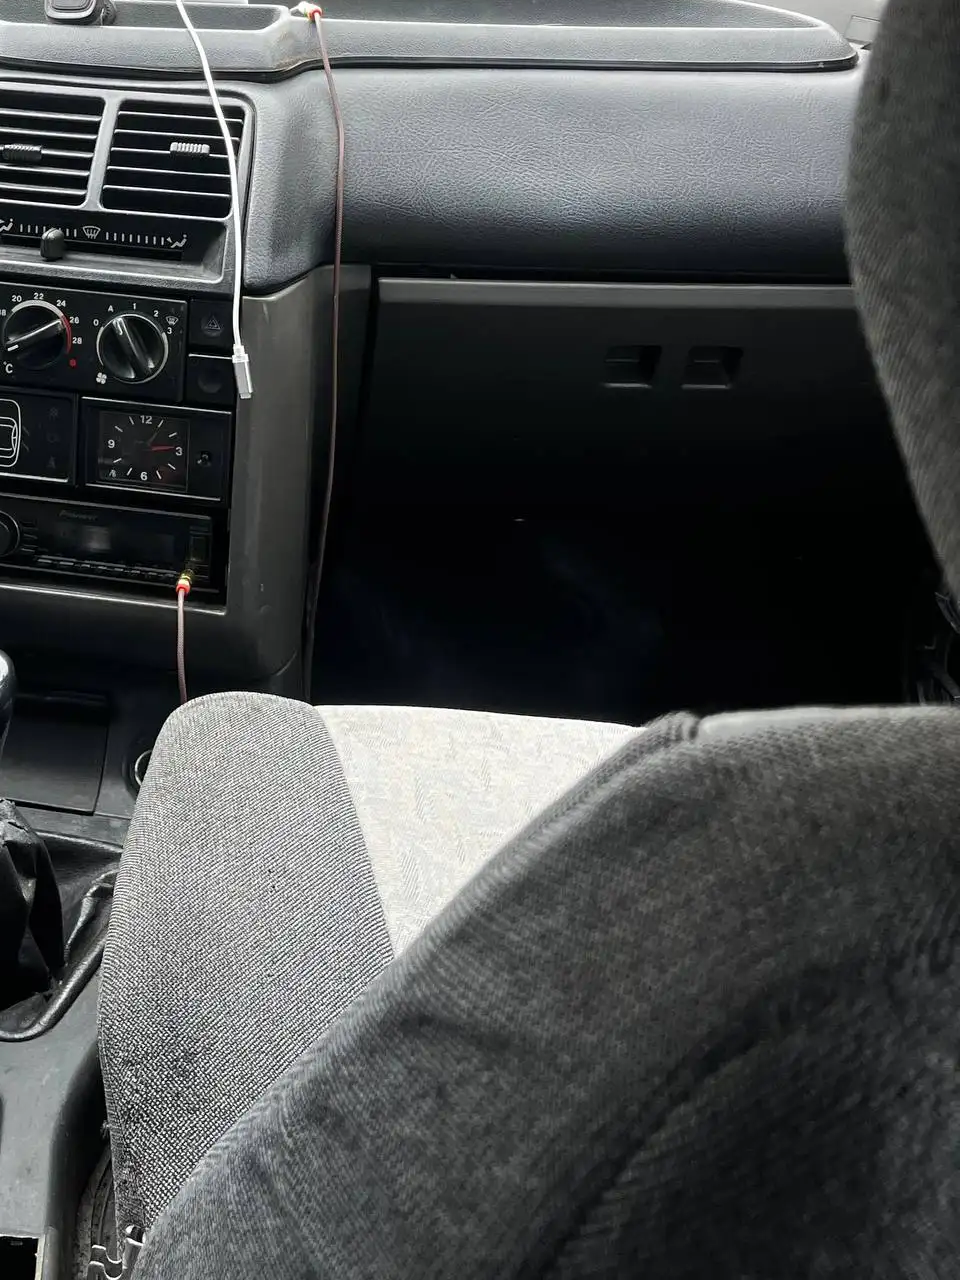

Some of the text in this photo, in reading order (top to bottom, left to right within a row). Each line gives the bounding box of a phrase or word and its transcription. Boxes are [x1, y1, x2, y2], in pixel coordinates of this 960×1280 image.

[11, 294, 22, 303] 20
[33, 292, 44, 300] 22
[56, 299, 66, 307] 24
[107, 305, 114, 313] A
[69, 316, 80, 324] 26
[166, 327, 173, 335] 3
[72, 337, 83, 345] 28
[139, 415, 153, 425] 12
[107, 439, 116, 449] 9
[175, 446, 183, 456] 3
[140, 471, 148, 481] 6
